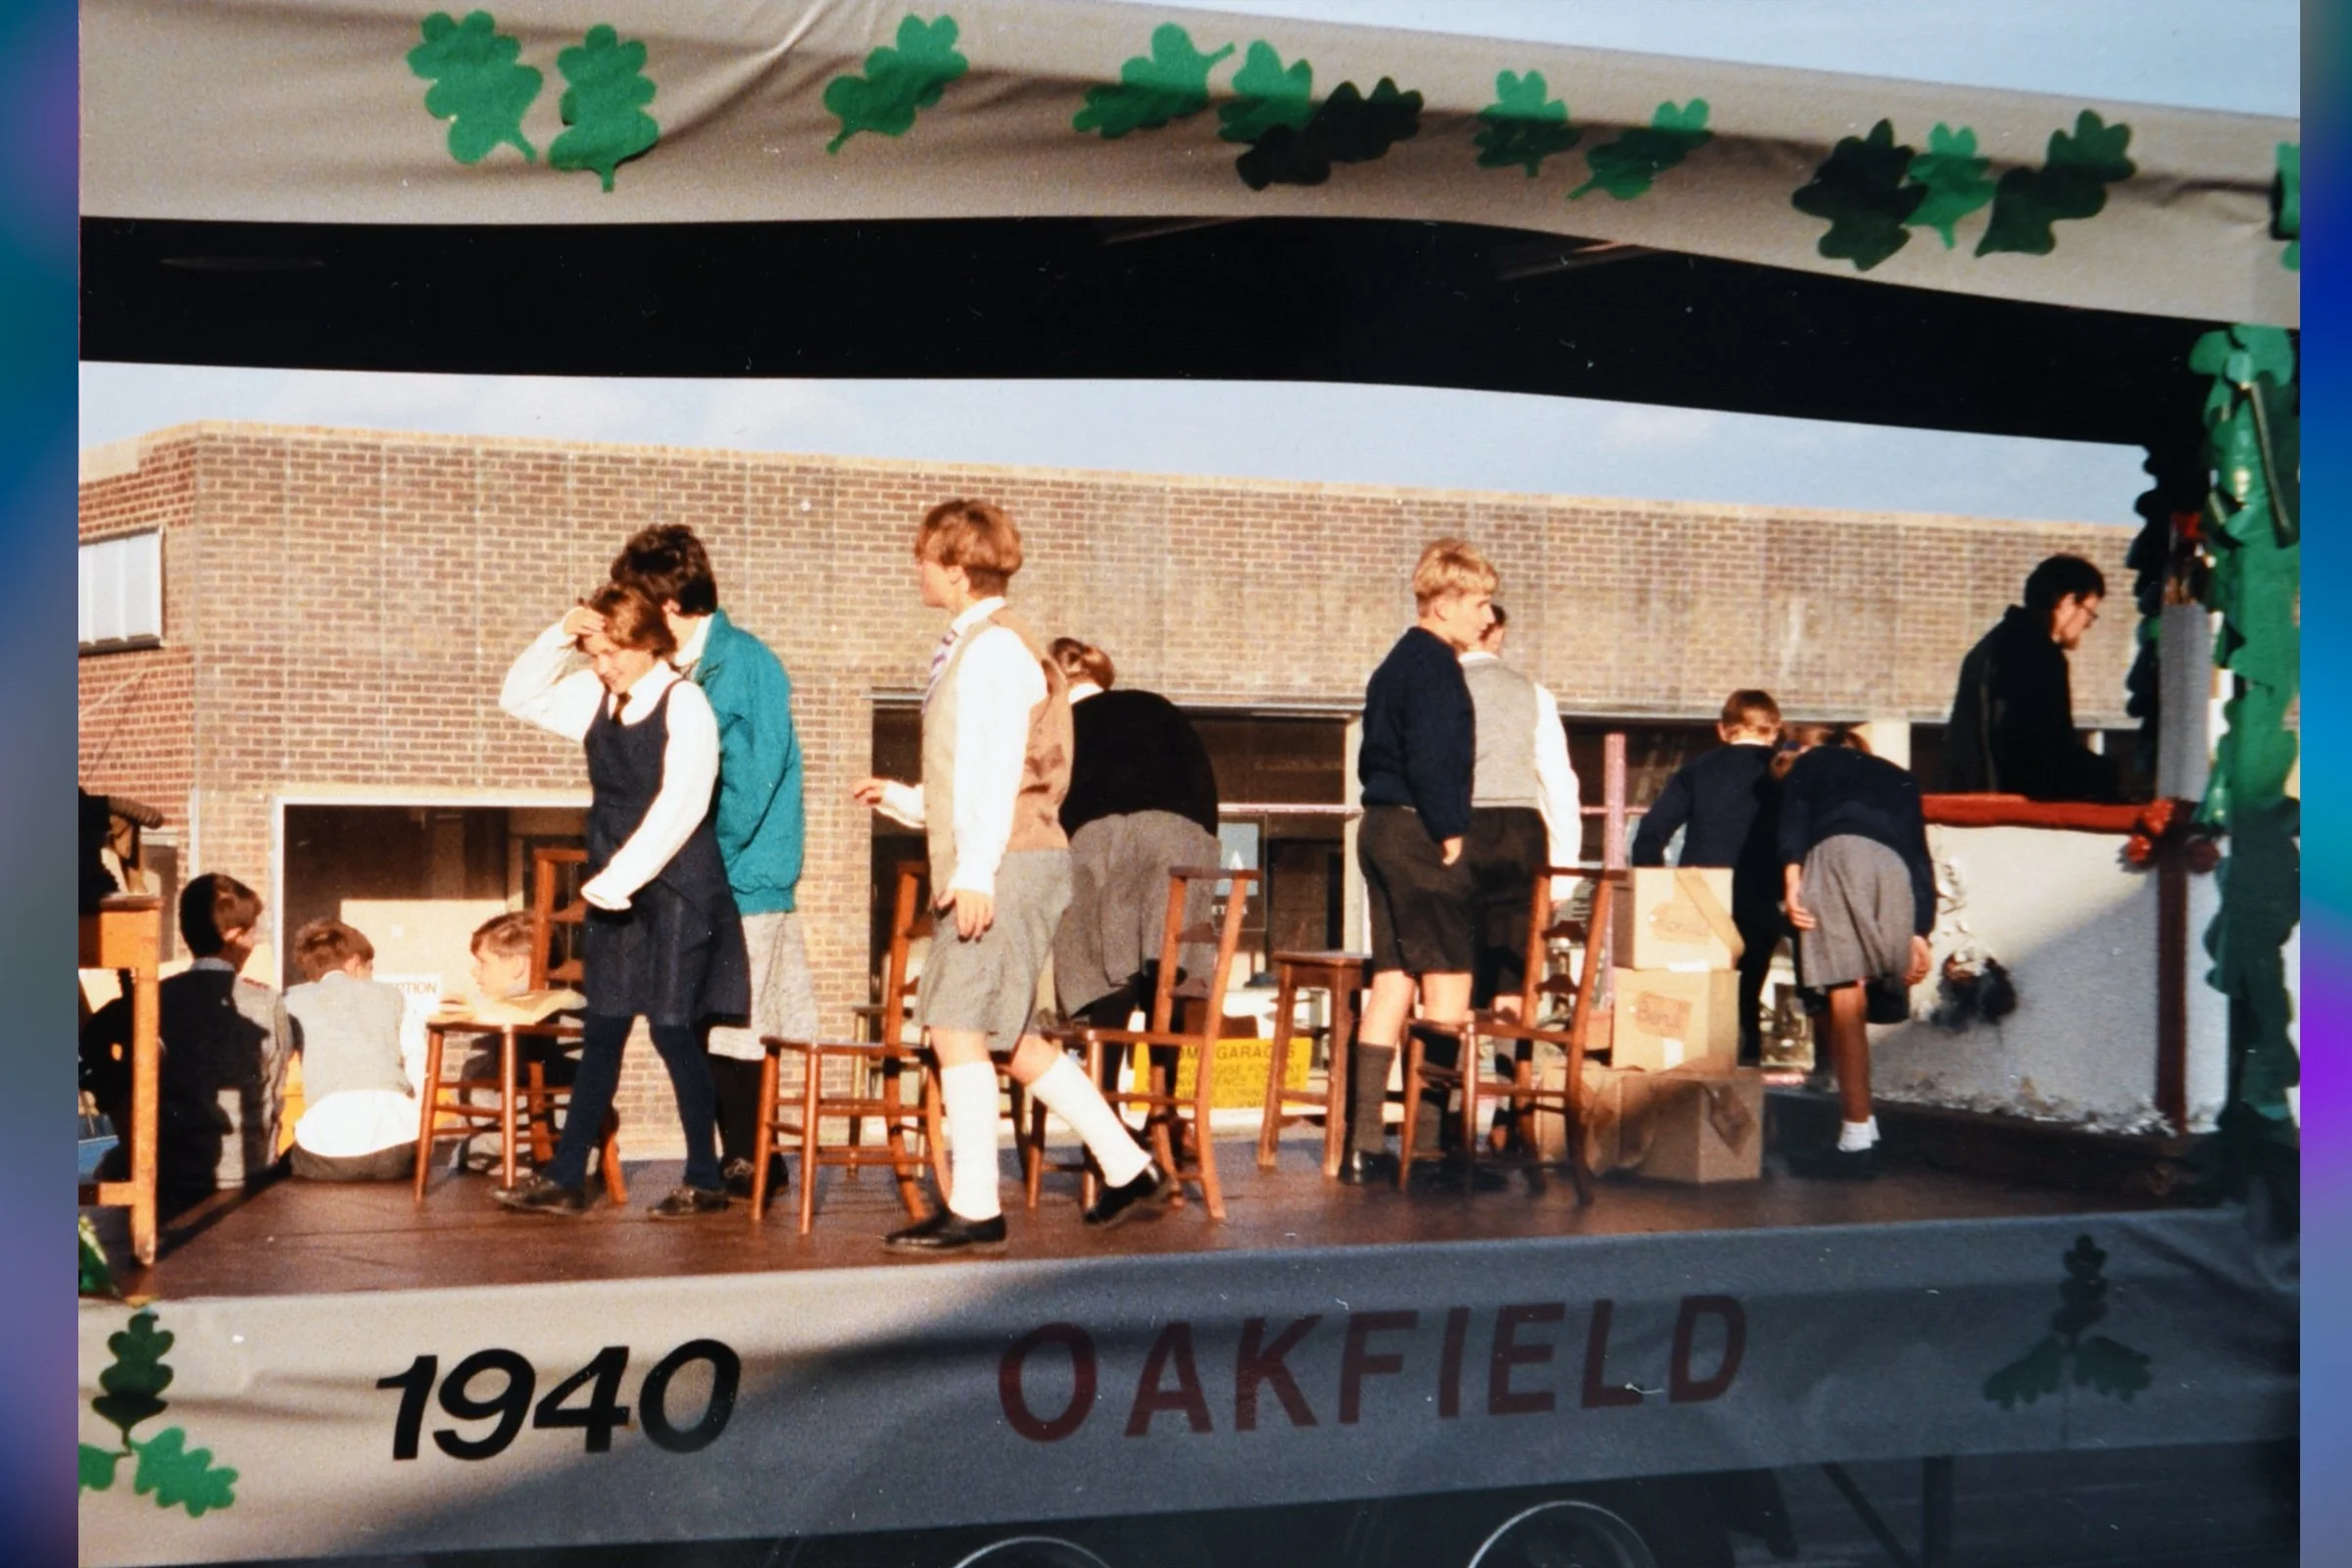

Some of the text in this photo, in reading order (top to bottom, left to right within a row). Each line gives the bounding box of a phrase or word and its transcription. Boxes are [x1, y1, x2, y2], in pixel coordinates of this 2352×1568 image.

[1216, 1045, 1296, 1059] GARAGS
[375, 1294, 1747, 1460] 1940 OAKFIELD
